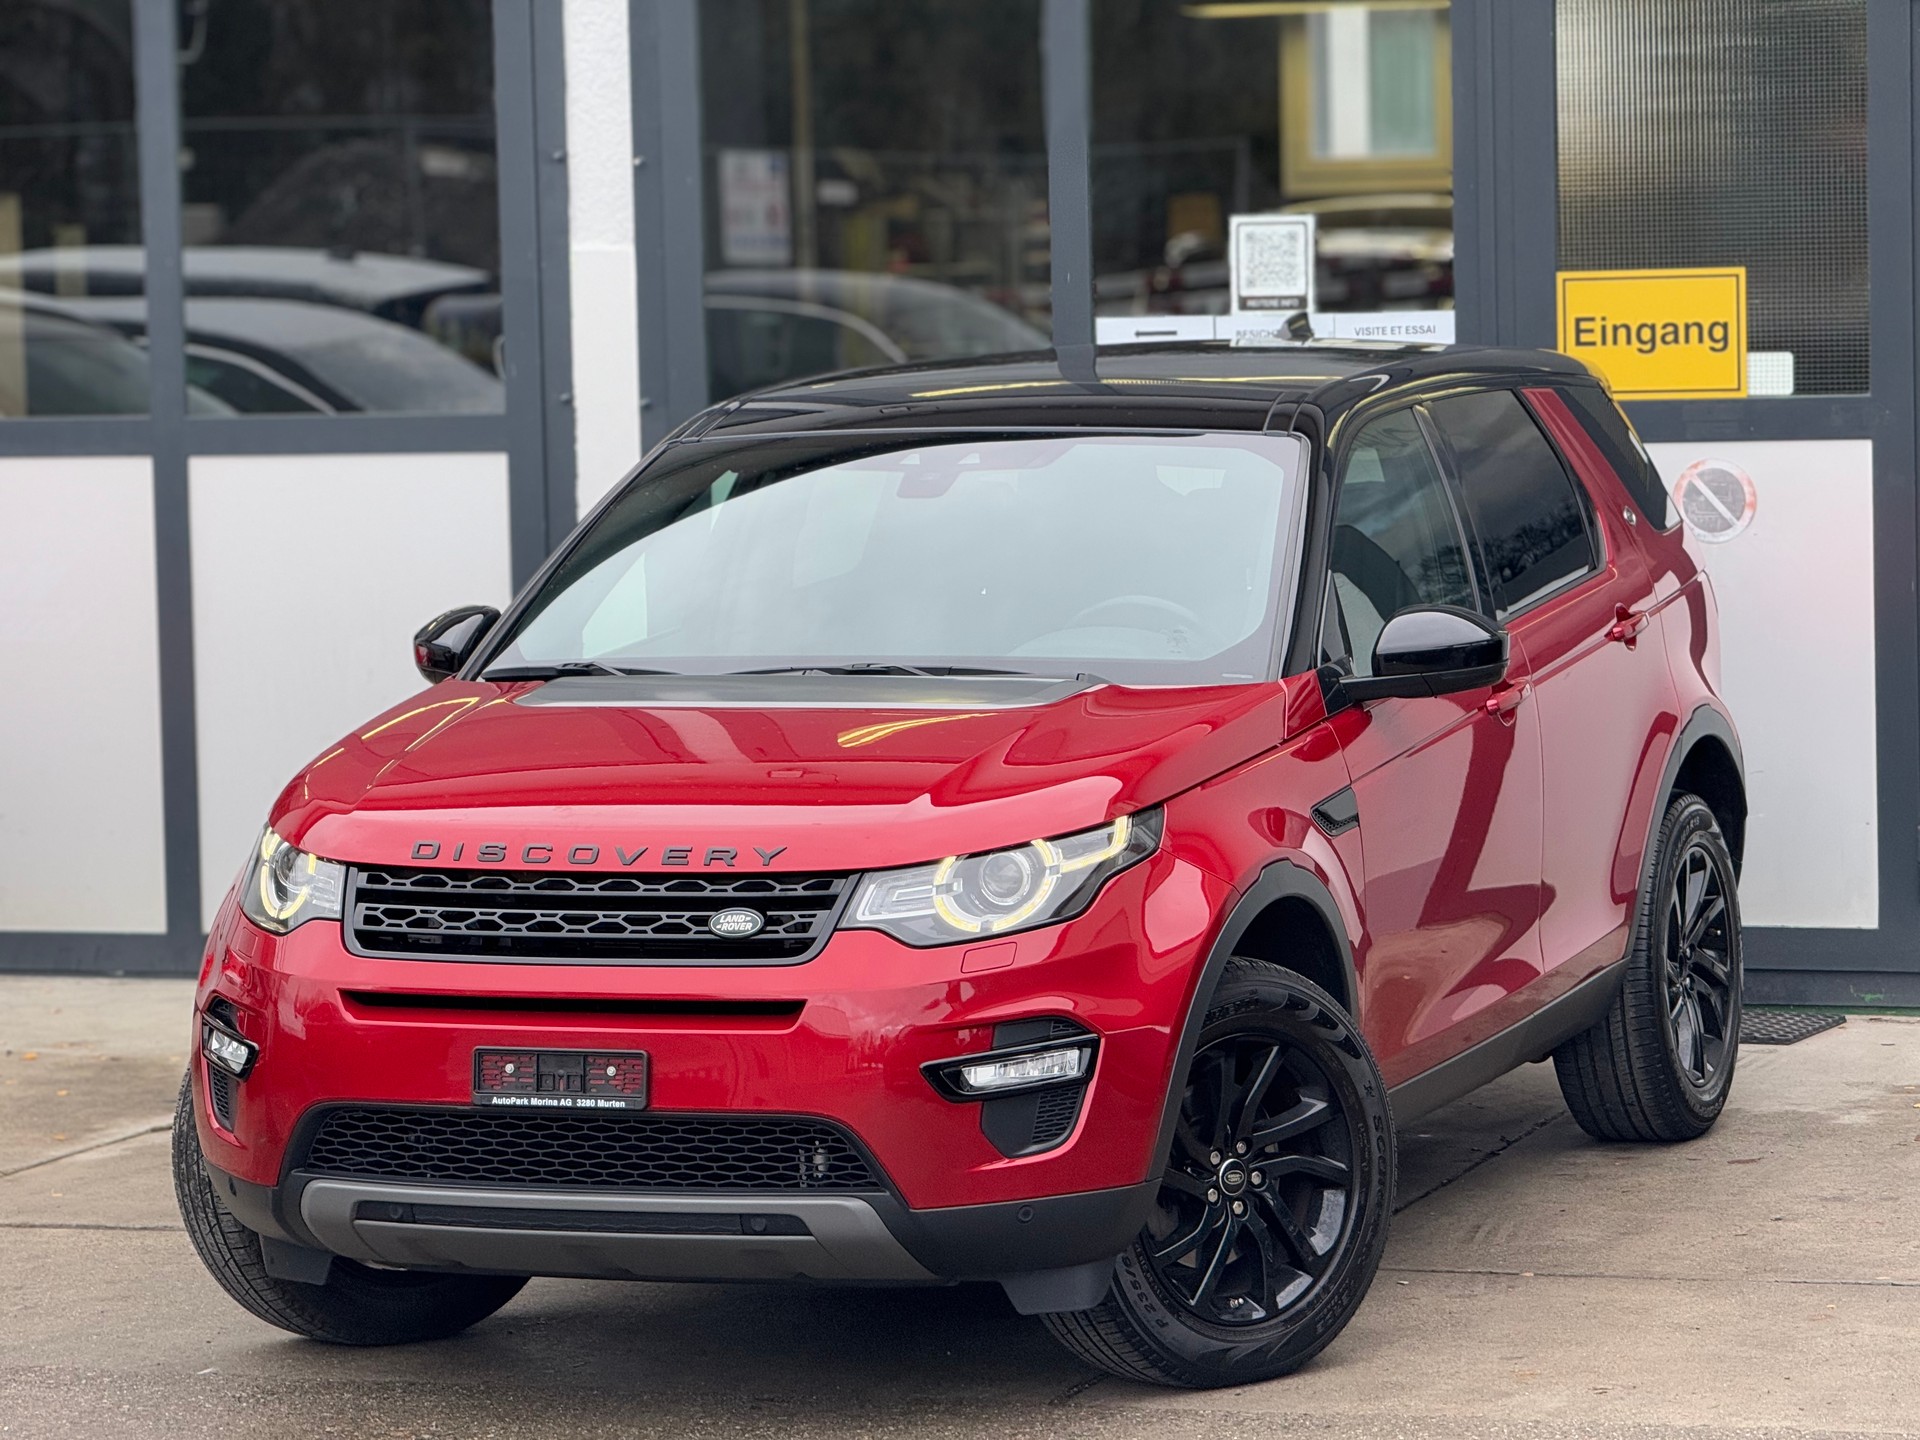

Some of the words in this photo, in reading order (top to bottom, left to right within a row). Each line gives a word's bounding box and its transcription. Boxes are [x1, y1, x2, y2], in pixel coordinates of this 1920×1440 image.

[1353, 326, 1389, 337] VISITE
[1390, 325, 1403, 335] ET
[1405, 324, 1436, 335] ESSAI
[1574, 316, 1730, 354] Eingang
[411, 840, 788, 866] DISCOVERY
[720, 914, 746, 923] LAND
[720, 922, 753, 931] ROVER
[492, 1096, 529, 1106] AutoPark
[530, 1097, 558, 1107] Morina
[559, 1099, 573, 1107] AG
[576, 1099, 596, 1108] 3280
[597, 1100, 626, 1109] Murten
[1121, 1255, 1157, 1314] 235/6
